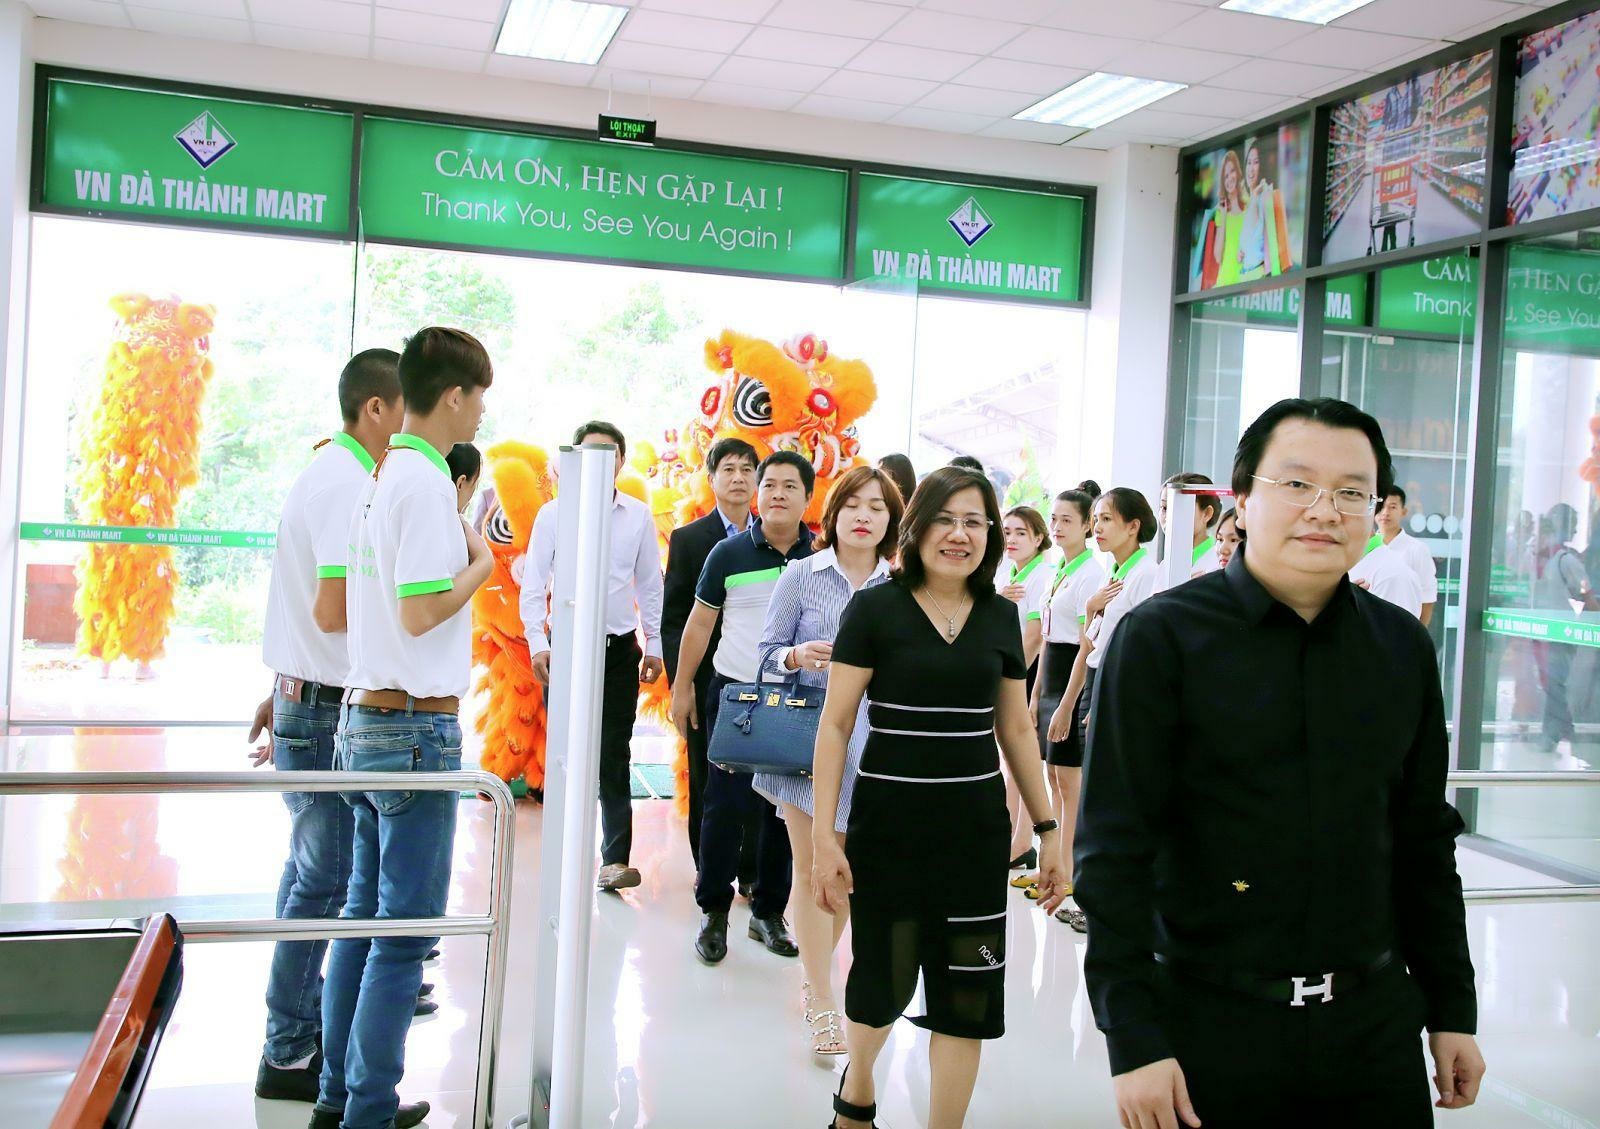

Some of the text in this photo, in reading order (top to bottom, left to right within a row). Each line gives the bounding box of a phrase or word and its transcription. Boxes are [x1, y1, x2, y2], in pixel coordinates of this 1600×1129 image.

[615, 131, 637, 139] EXIT
[435, 148, 784, 213] CẢM ƠN, HẸN GẶP LẠI !
[74, 169, 327, 224] VN ĐÀ THÀNH MART
[421, 191, 793, 252] Thank You, See You Again !
[872, 248, 1062, 294] VN ĐÀ THÀNH MART
[1524, 267, 1570, 295] HẸN
[1413, 291, 1473, 318] Thank
[1524, 303, 1561, 325] See
[1567, 307, 1600, 328] You
[54, 528, 65, 538] VN
[101, 531, 122, 540] MART
[157, 533, 167, 543] VN
